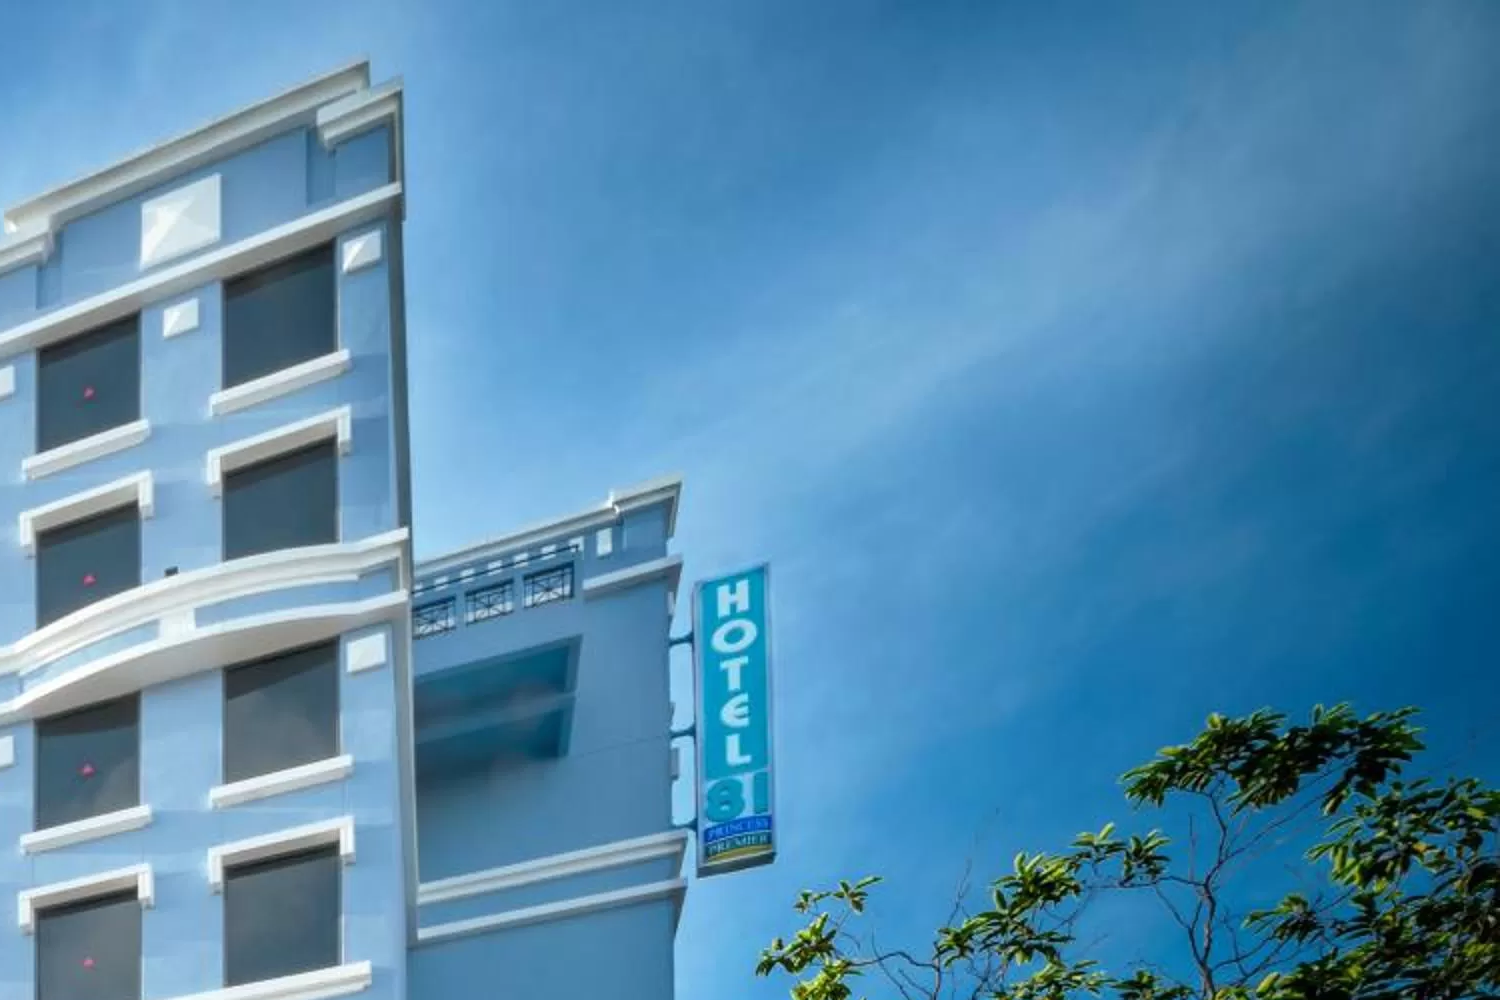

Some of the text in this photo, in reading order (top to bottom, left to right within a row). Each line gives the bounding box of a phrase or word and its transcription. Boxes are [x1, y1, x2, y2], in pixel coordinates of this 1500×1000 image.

[711, 579, 758, 767] HOTEL
[707, 772, 769, 823] 81
[708, 834, 767, 855] PREMIER
